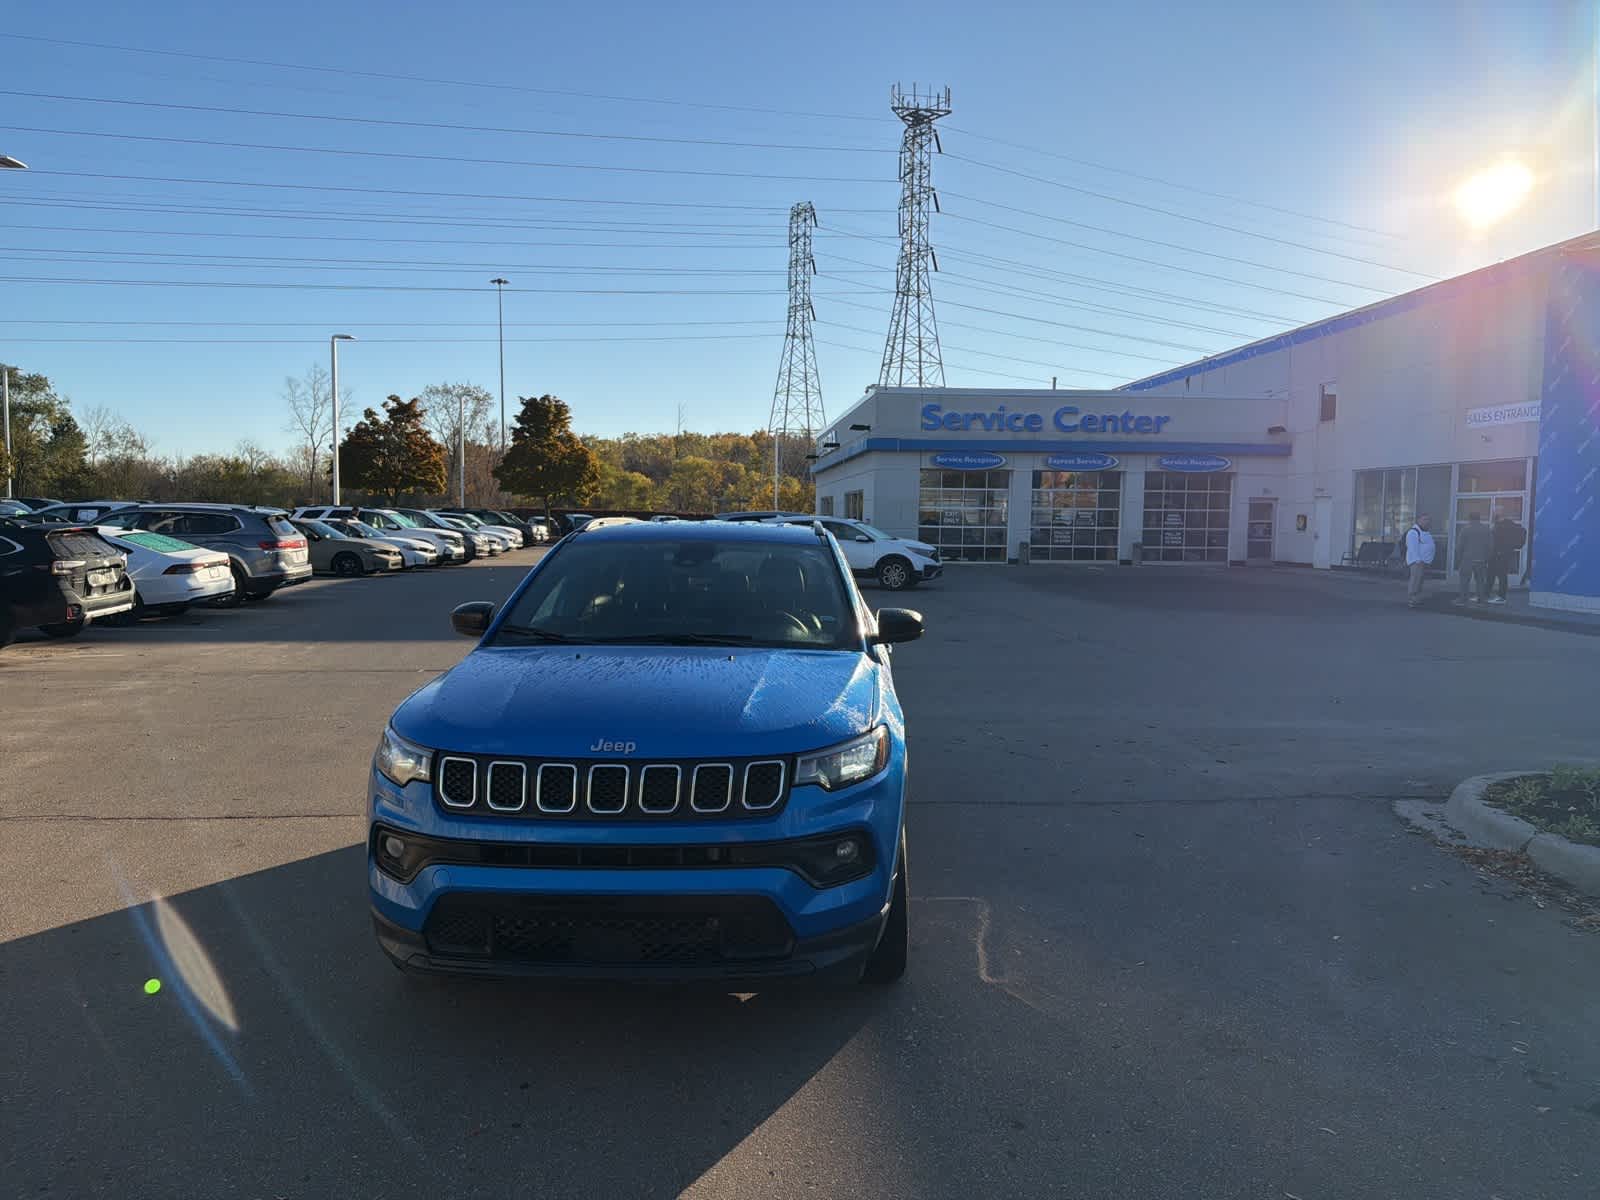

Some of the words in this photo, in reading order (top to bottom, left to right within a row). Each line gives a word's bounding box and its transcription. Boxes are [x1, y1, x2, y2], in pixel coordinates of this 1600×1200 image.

[921, 403, 1043, 432] Service
[1054, 406, 1171, 433] Center
[935, 455, 963, 464] Service
[590, 738, 637, 755] Jeep
